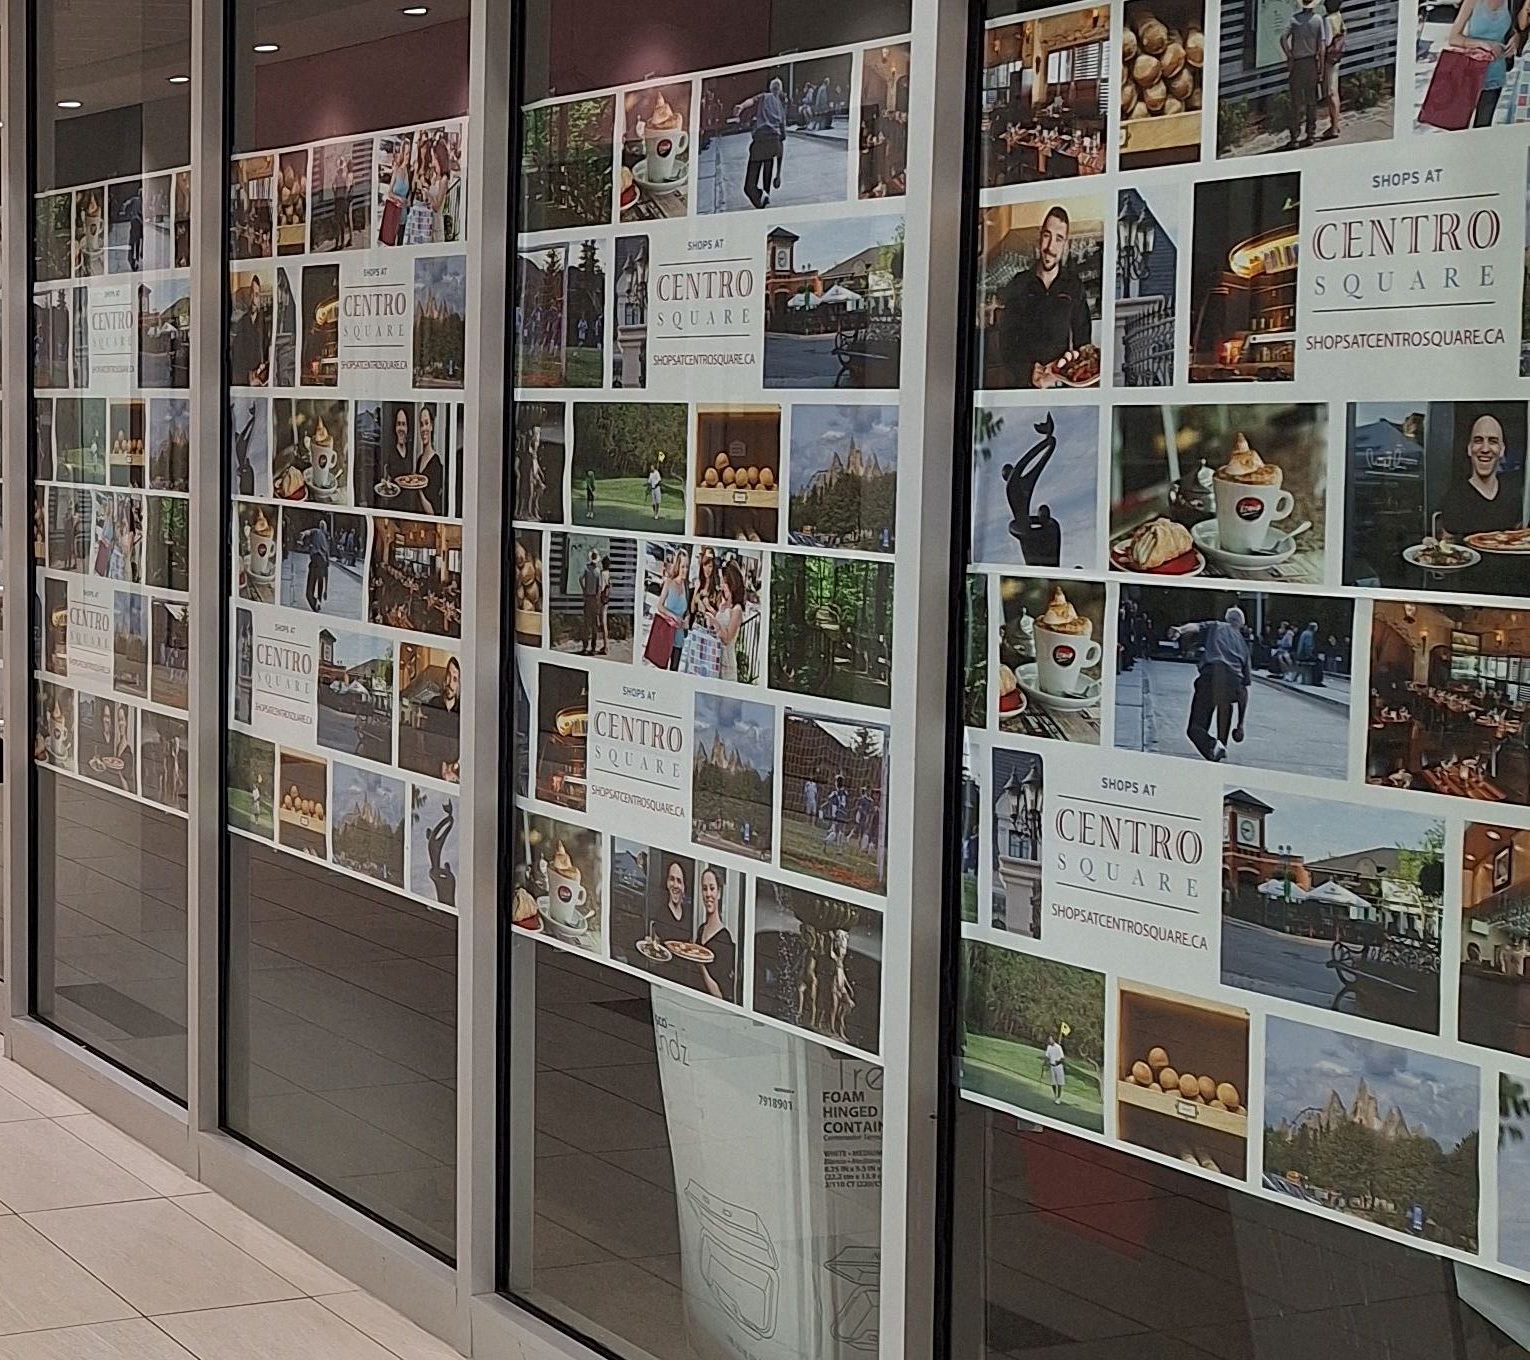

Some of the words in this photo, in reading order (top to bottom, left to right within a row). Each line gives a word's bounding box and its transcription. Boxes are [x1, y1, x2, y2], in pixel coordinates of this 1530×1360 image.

[1372, 171, 1420, 188] SHOPS
[1425, 168, 1444, 183] AT
[687, 239, 712, 251] SHOPS
[714, 238, 724, 249] AT
[1312, 209, 1500, 260] CENTRO
[656, 269, 753, 301] CENTRO
[1314, 264, 1495, 300] SQUARE
[343, 292, 407, 317] CENTRO
[92, 311, 134, 331] CENTRO
[657, 308, 750, 331] SQUARE
[343, 324, 404, 341] SQUARE
[1306, 328, 1505, 350] SHOPSATCENTROSQUARE.CA
[653, 353, 755, 366] SHOPSATCENTROSQUARE.CA
[70, 607, 110, 632] CENTRO
[256, 643, 312, 675] CENTRO
[622, 686, 645, 699] SHOPS
[647, 691, 656, 701] AT
[594, 711, 683, 753] CENTRO
[595, 745, 680, 778] SQUARE
[1101, 777, 1139, 794] SHOPS
[1142, 783, 1157, 797] AT
[591, 784, 685, 818] SHOPSATCENTROSQUARE.CA
[1055, 808, 1203, 865] CENTRO
[1057, 853, 1198, 898] SQUARE
[1051, 903, 1208, 951] SHOPSATCENTROSQUARE.CA
[822, 1091, 865, 1103] FOAM
[823, 1106, 878, 1118] HINGED
